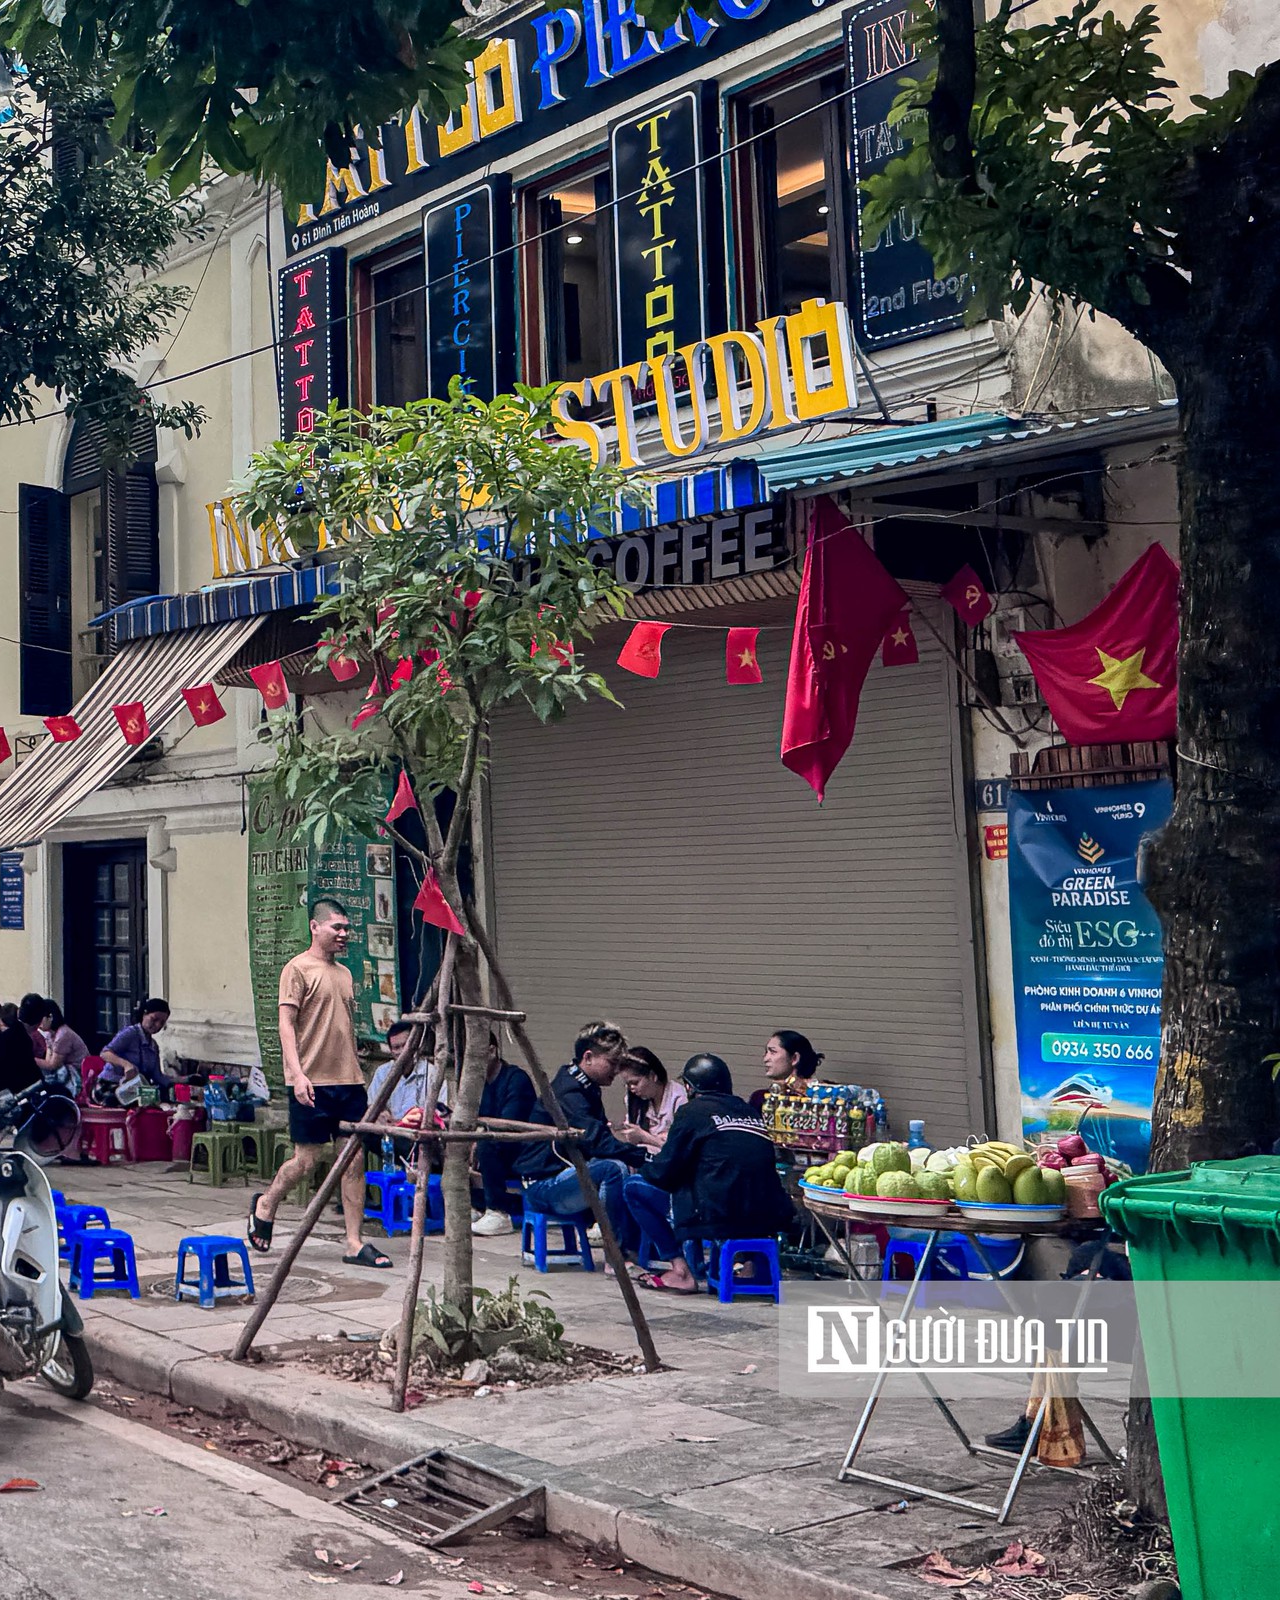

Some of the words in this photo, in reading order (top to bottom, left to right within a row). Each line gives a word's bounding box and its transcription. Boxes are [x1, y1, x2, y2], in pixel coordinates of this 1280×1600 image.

[297, 38, 523, 227] ATTOO
[531, 0, 770, 110] PIE
[301, 231, 311, 246] 61
[352, 202, 380, 223] Hoàng
[636, 110, 677, 374] TATTOO
[867, 288, 906, 319] 2nd
[912, 273, 968, 305] Floor
[551, 298, 857, 470] STUDIO
[585, 508, 774, 593] COFFEE
[982, 784, 1003, 806] 61
[1062, 876, 1116, 890] GREEN
[1051, 891, 1131, 906] PARADISE
[1045, 919, 1071, 933] Siêu
[1024, 984, 1057, 996] PHÒNG
[1059, 986, 1081, 996] KINH
[1083, 987, 1118, 997] DOANH
[1120, 988, 1126, 998] 6
[1084, 1003, 1110, 1013] CHÍNH
[1051, 1040, 1088, 1057] 0934
[1093, 1043, 1121, 1059] 350
[1125, 1045, 1154, 1060] 666
[836, 1118, 848, 1132] C2
